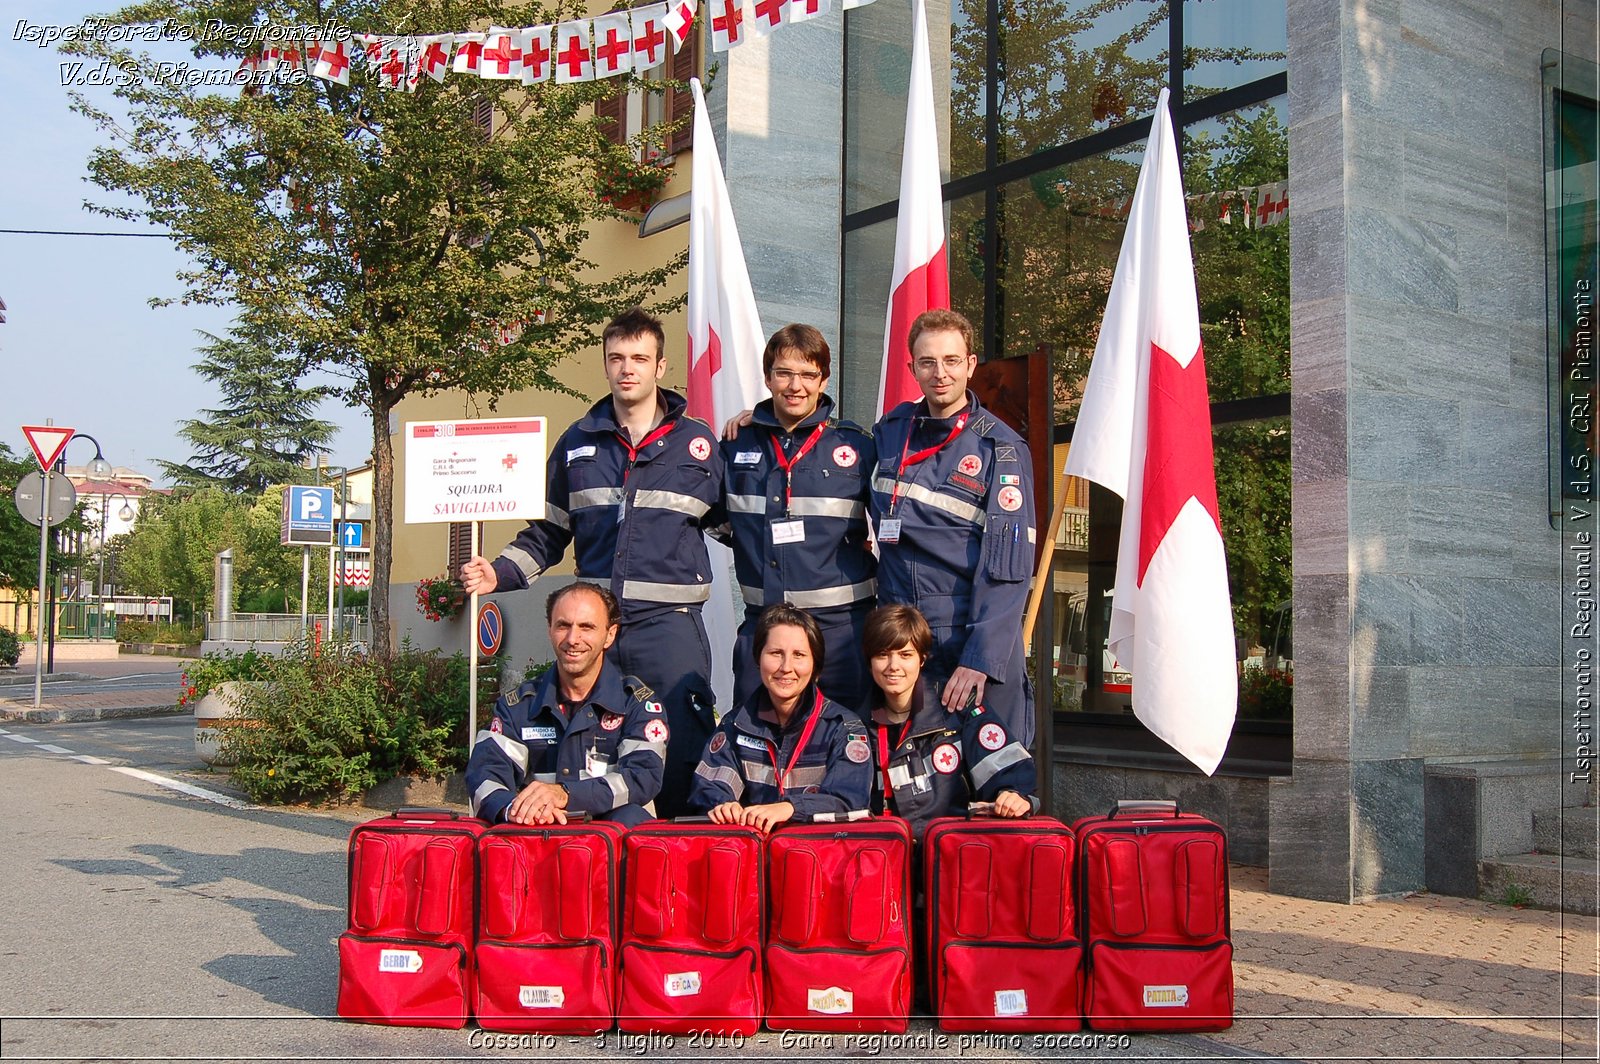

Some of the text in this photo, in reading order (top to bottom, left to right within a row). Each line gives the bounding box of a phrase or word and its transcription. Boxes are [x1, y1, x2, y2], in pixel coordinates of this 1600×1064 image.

[447, 483, 503, 497] SQUADRA
[433, 500, 517, 515] SAVIGLIANO
[383, 955, 410, 968] GERBY
[1146, 990, 1177, 1003] PATATA
